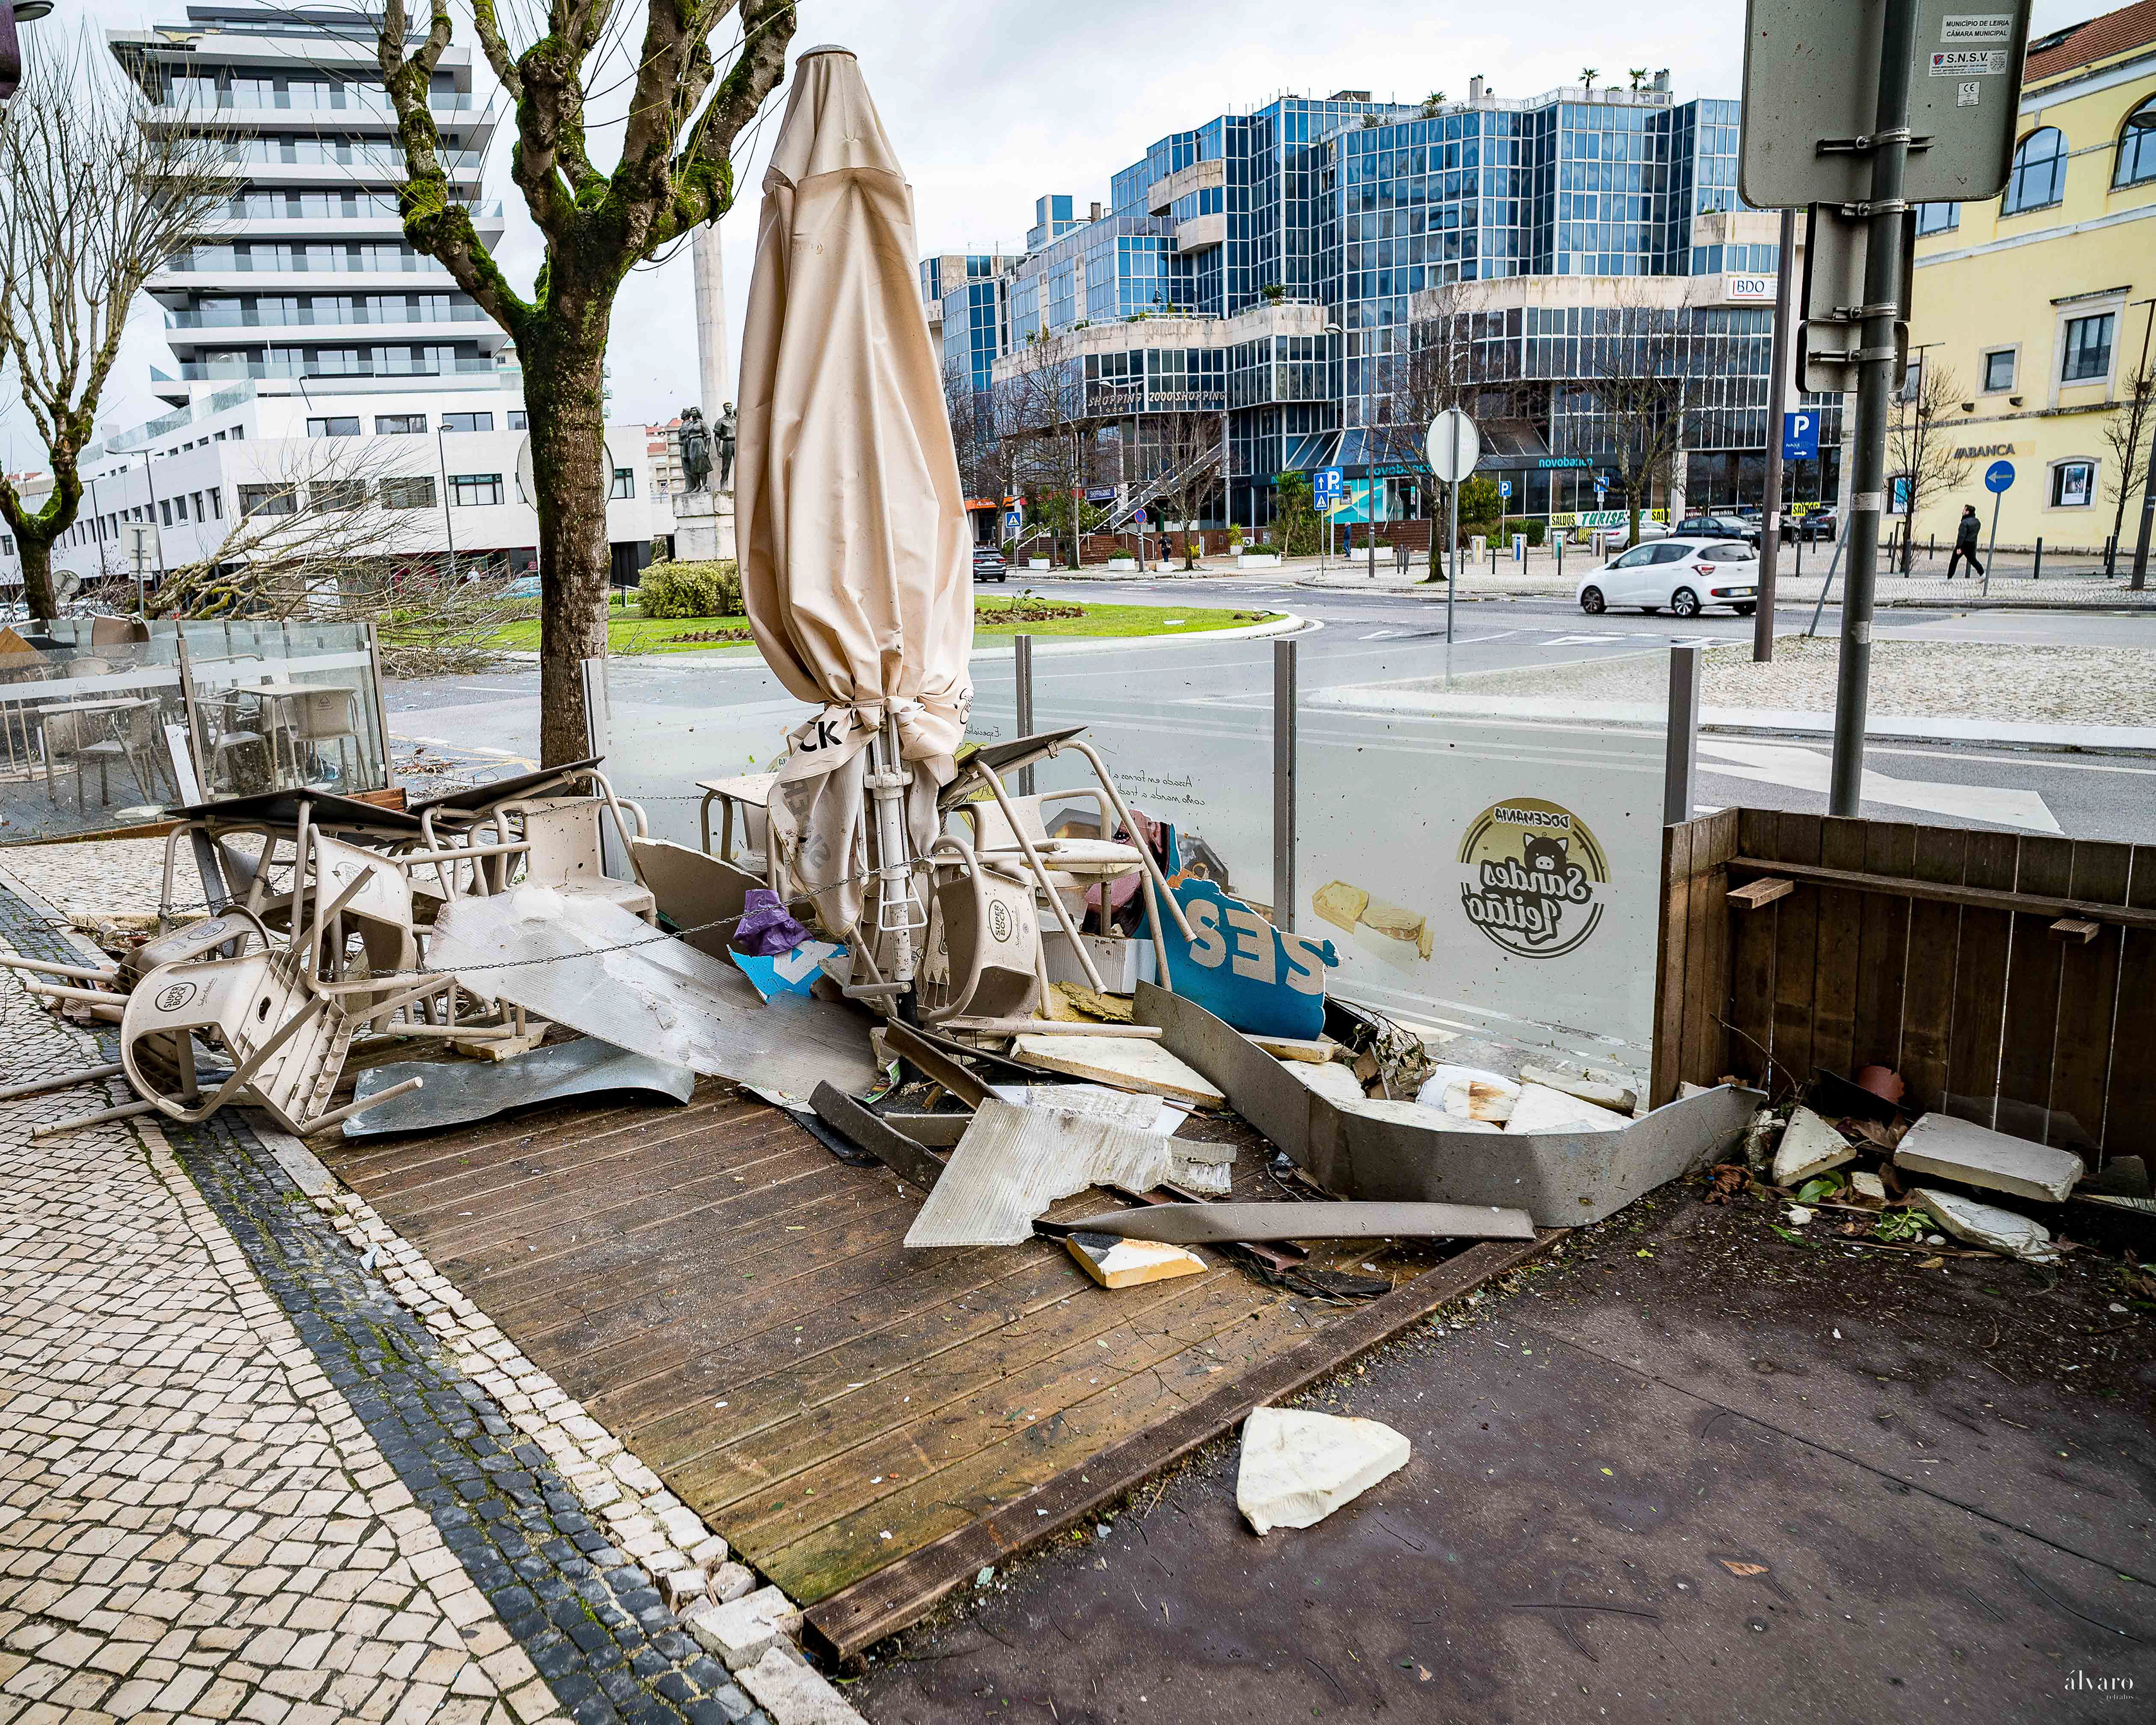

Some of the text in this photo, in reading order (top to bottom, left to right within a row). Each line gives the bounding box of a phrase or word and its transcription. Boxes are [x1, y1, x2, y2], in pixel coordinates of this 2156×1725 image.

[1947, 52, 1988, 63] S.N.S.V.
[1737, 280, 1765, 293] BDO
[1088, 391, 1226, 407] SHOPPING 2000 SHOPPING
[1794, 416, 1810, 438] P
[1538, 456, 1593, 468] novobanco
[1501, 482, 1509, 495] P
[1552, 514, 1575, 526] SALDOS
[163, 986, 181, 1008] SUPER
[172, 986, 189, 1006] BOCK
